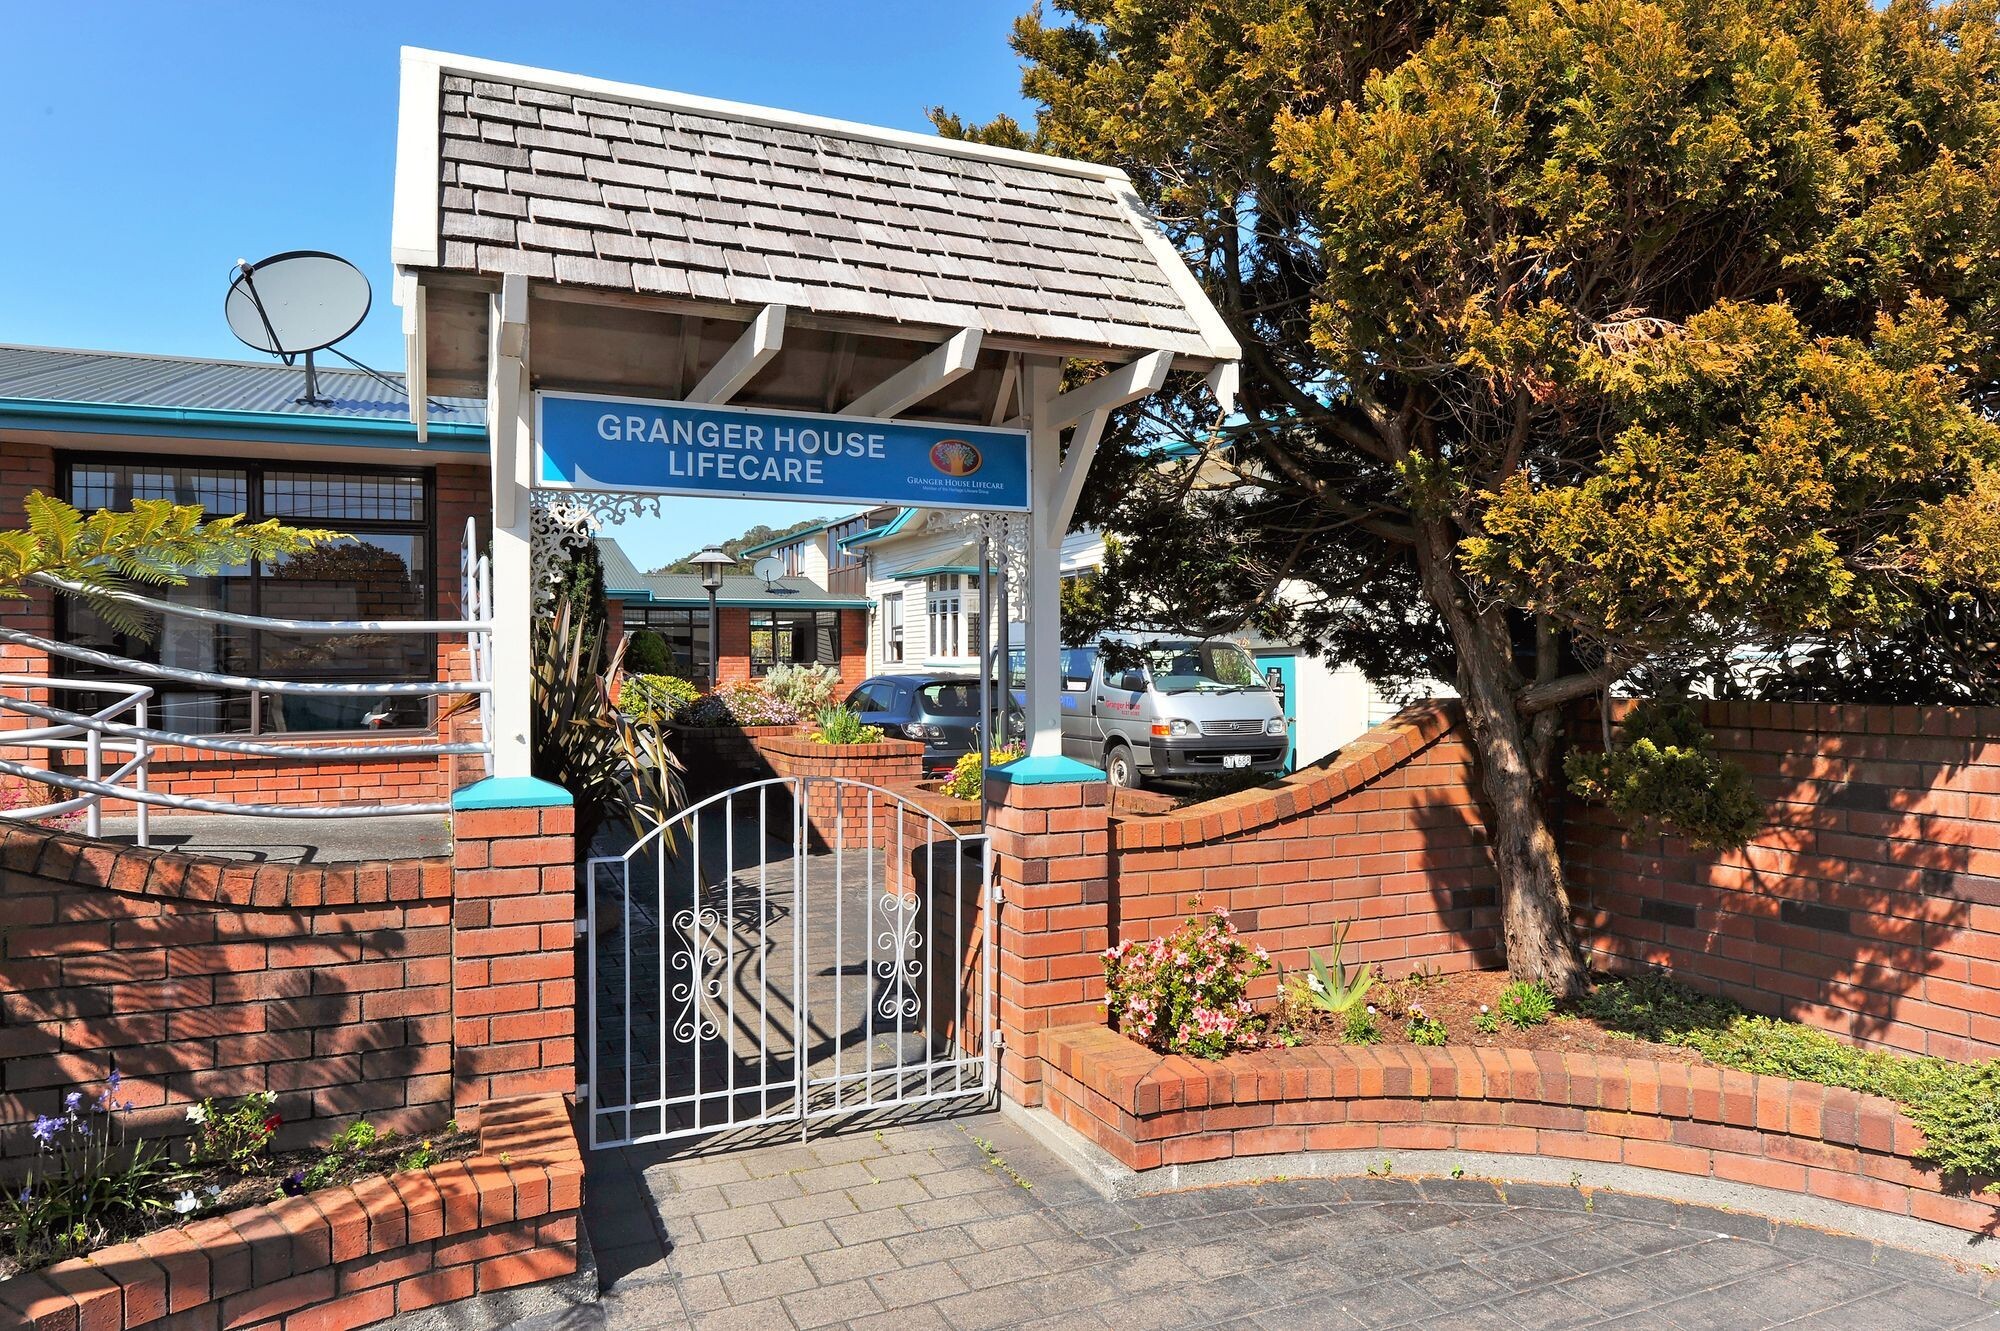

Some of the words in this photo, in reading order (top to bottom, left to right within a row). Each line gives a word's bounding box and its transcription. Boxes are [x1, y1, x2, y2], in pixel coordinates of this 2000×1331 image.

[597, 413, 764, 451] GRANGER
[774, 427, 886, 459] HOUSE
[668, 450, 824, 484] LIFECARE
[907, 476, 943, 485] GRANGER
[945, 479, 969, 487] HOUSE
